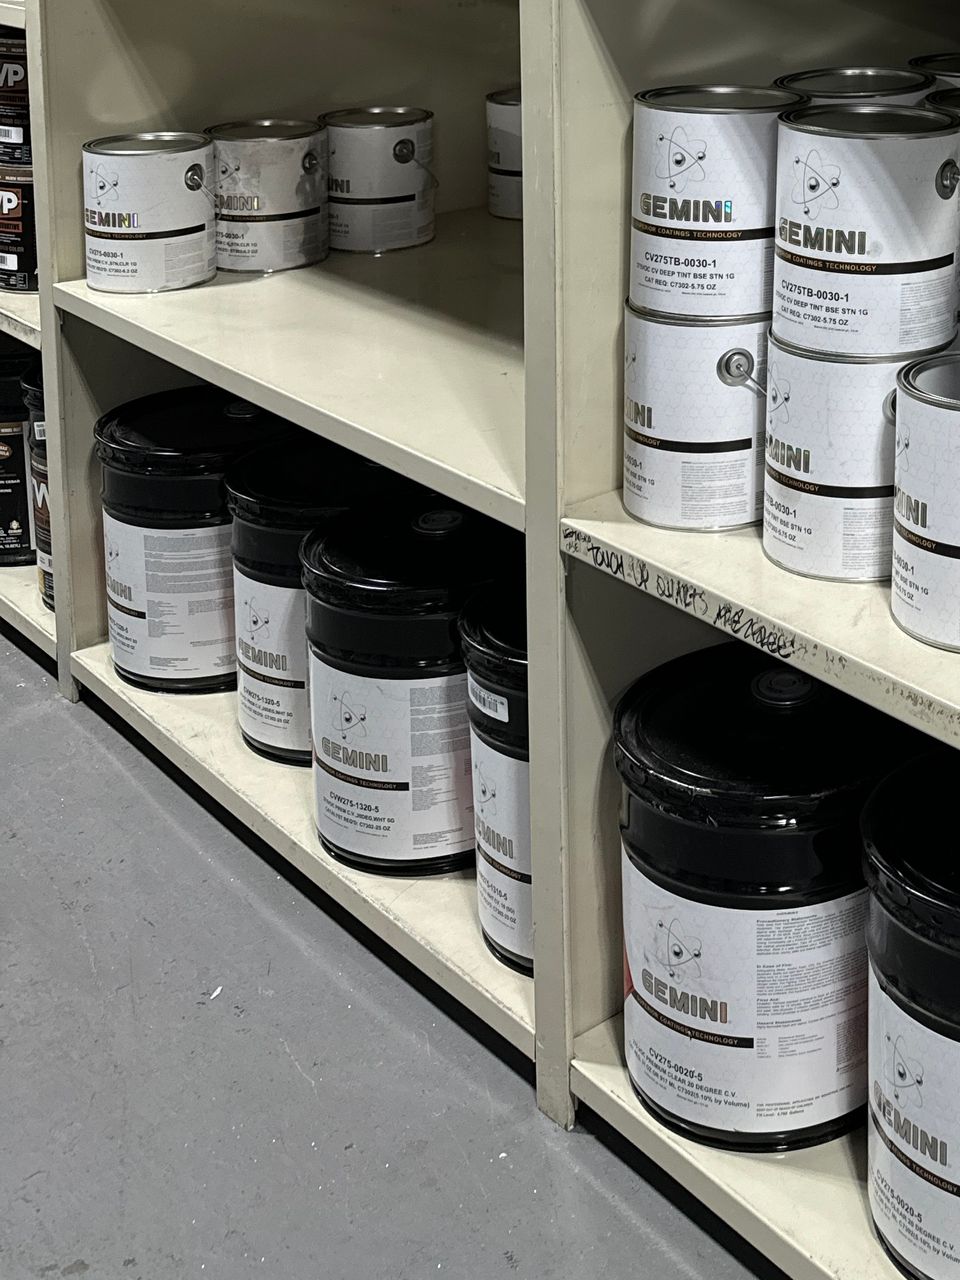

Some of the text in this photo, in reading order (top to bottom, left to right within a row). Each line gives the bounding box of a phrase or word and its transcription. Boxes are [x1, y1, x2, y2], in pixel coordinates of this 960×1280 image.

[640, 192, 732, 223] GEMINI
[658, 228, 690, 237] COATINGS
[779, 217, 866, 255] GEMINI
[645, 251, 717, 268] CV275TB-0030-1
[793, 255, 877, 272] COATINGS TECHNOLOGY
[660, 268, 675, 277] DEEP
[781, 279, 849, 302] CV275TB-0030-1
[794, 298, 808, 308] DEEP
[809, 303, 823, 312] TINT
[825, 306, 839, 314] BSE
[780, 475, 819, 492] TECHNOLOGY
[322, 736, 387, 772] GEMINI
[641, 968, 728, 1024] GEMINI
[691, 1029, 738, 1045] TECHNOLOGY
[648, 1047, 704, 1082] CV275-0020-5
[910, 1162, 957, 1193] TECHNOLOGY
